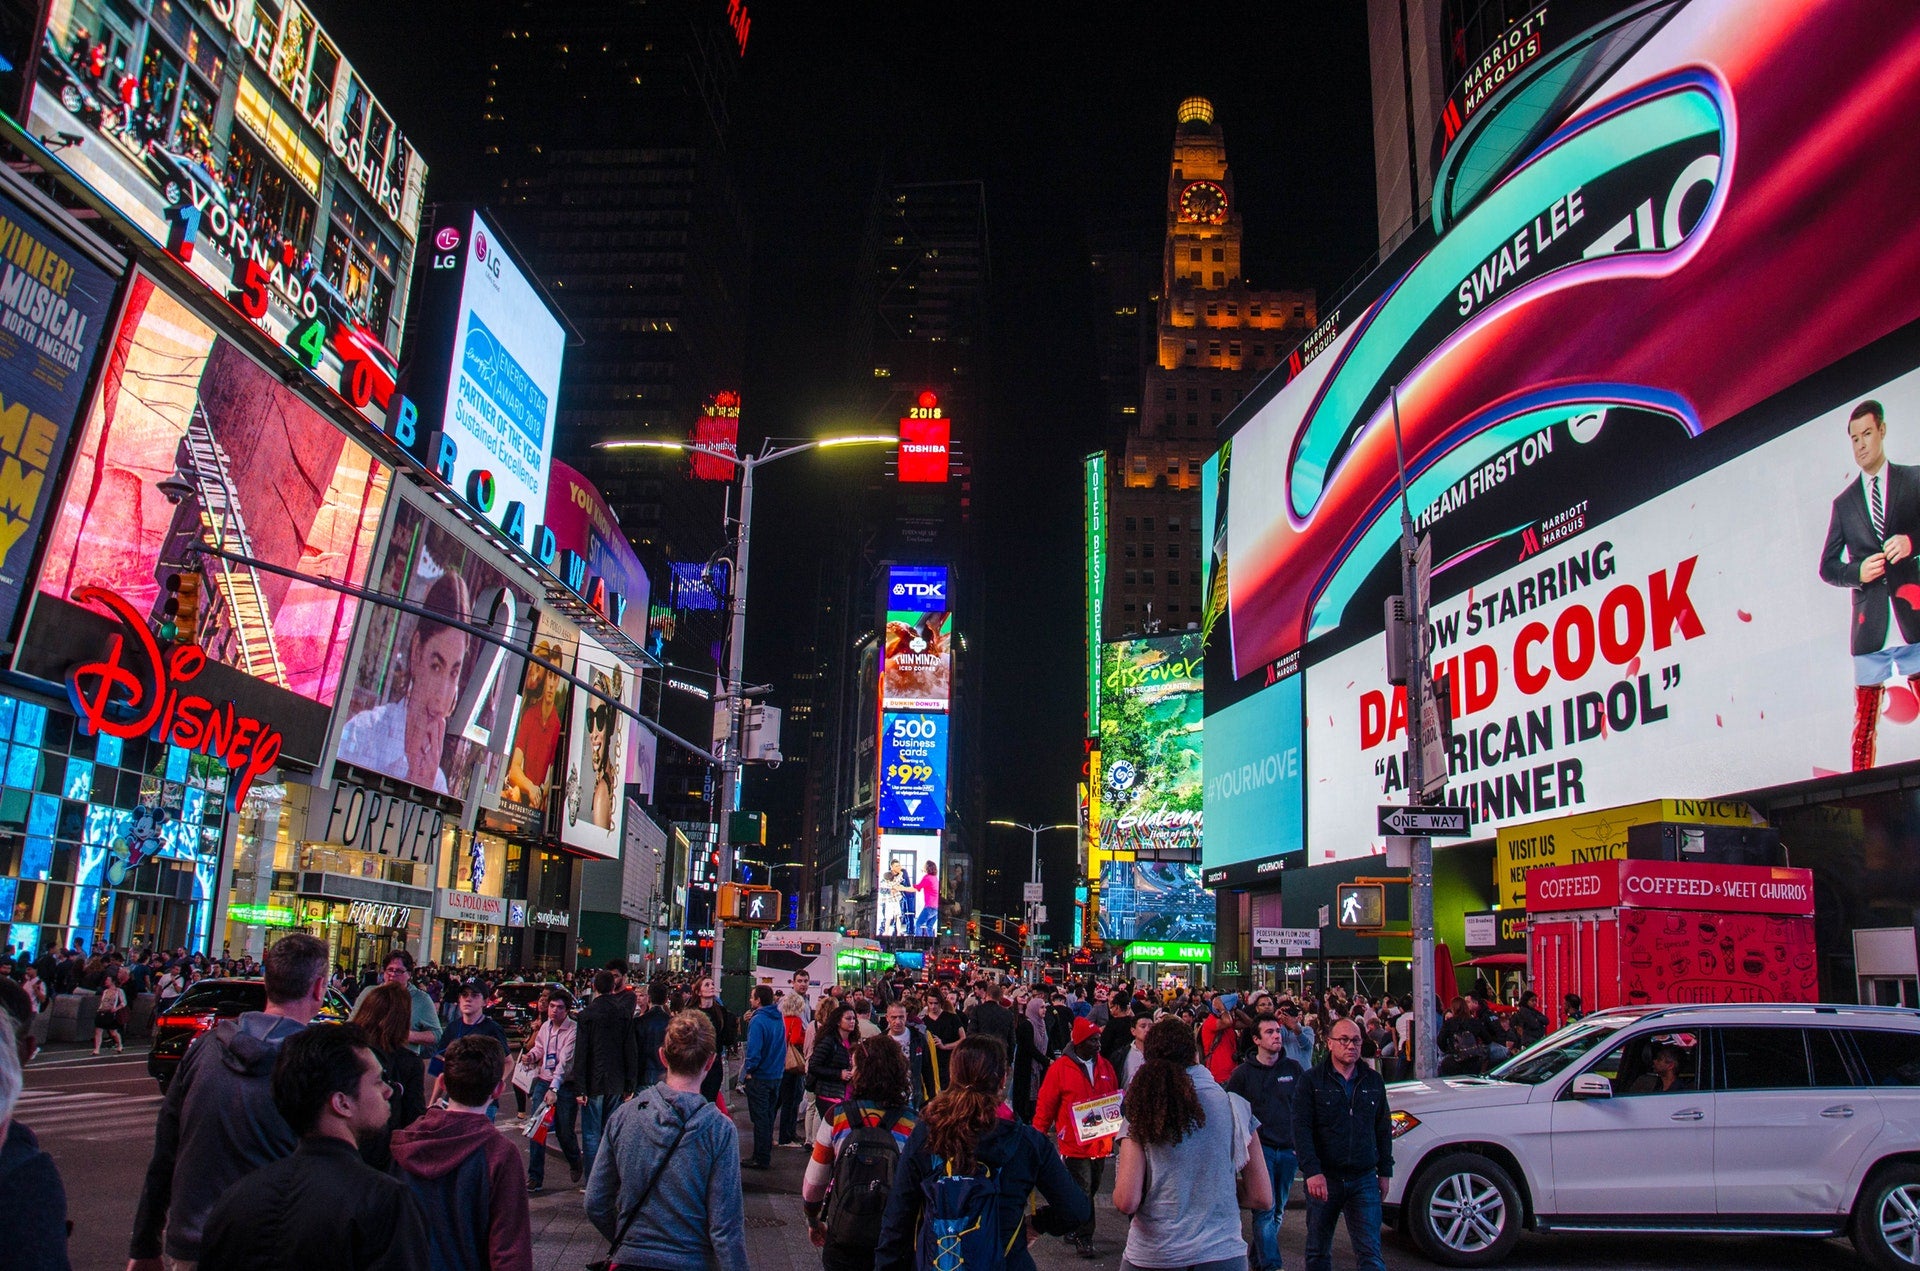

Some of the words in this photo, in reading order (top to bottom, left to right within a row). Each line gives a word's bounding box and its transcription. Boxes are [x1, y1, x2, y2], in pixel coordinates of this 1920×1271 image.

[1463, 8, 1548, 93] MARRIOTT
[1465, 39, 1538, 114] MARQUIS
[288, 66, 400, 222] FLAGSHIPS
[190, 180, 318, 319] VORNADO
[433, 254, 457, 270] LG
[487, 248, 501, 279] LG
[1458, 228, 1531, 317] SWAE
[1535, 186, 1585, 254] LEE
[1, 312, 37, 345] NORTH
[35, 331, 81, 373] AMERICA
[1303, 311, 1341, 352] MARRIOTT
[1303, 329, 1338, 366] MARQUIS
[500, 353, 528, 393] ENERGY
[528, 386, 547, 417] STAR
[458, 374, 496, 428] PARTNER
[496, 409, 508, 435] OF
[507, 421, 522, 454] THE
[522, 434, 542, 474] YEAR
[496, 380, 525, 419] AWARD
[526, 408, 542, 439] 2018
[910, 408, 942, 419] 2018
[455, 398, 498, 455] Sustained
[498, 438, 540, 496] Excellence
[902, 444, 946, 453] TOSHIBA
[1413, 483, 1467, 533] TREAM
[1469, 453, 1519, 499] FIRST
[1521, 428, 1553, 466] ON
[569, 481, 593, 515] YOU
[1541, 500, 1588, 533] MARRIOTT
[1542, 517, 1584, 546] MARQUIS
[904, 584, 943, 595] TDK
[1466, 541, 1617, 636] STARRING
[893, 654, 915, 665] THIN
[915, 653, 942, 666] MINTS
[1276, 650, 1300, 669] MARRIOTT
[1360, 644, 1500, 752] DAID
[1513, 554, 1707, 695] COOK
[1107, 645, 1204, 696] discover
[1276, 662, 1299, 679] MARQUIS
[892, 738, 936, 748] business
[893, 719, 937, 739] 500
[899, 747, 928, 757] cards
[1207, 746, 1298, 803] #YOURMOVE
[323, 781, 442, 866] FOREVER
[1392, 814, 1419, 827] ONE
[1430, 814, 1458, 828] WAY
[1509, 837, 1538, 861] VISIT
[1540, 834, 1556, 857] US
[449, 891, 462, 908] U.S.
[463, 894, 481, 911] POLO
[482, 898, 502, 913] ASSN.
[1540, 875, 1601, 899] COFFEED
[1626, 876, 1713, 896] COFFEED
[1722, 881, 1757, 899] SWEET
[1759, 883, 1807, 901] CHURROS
[348, 901, 397, 928] FOREVER
[397, 907, 411, 929] 21
[460, 911, 475, 920] SINCE
[1256, 929, 1285, 937] PEDESTRIAN
[1285, 930, 1298, 938] FLOW
[1298, 930, 1311, 938] ZONE
[1179, 947, 1205, 957] NEW
[1676, 986, 1716, 1004] COFFEE
[1740, 987, 1765, 1004] TEA
